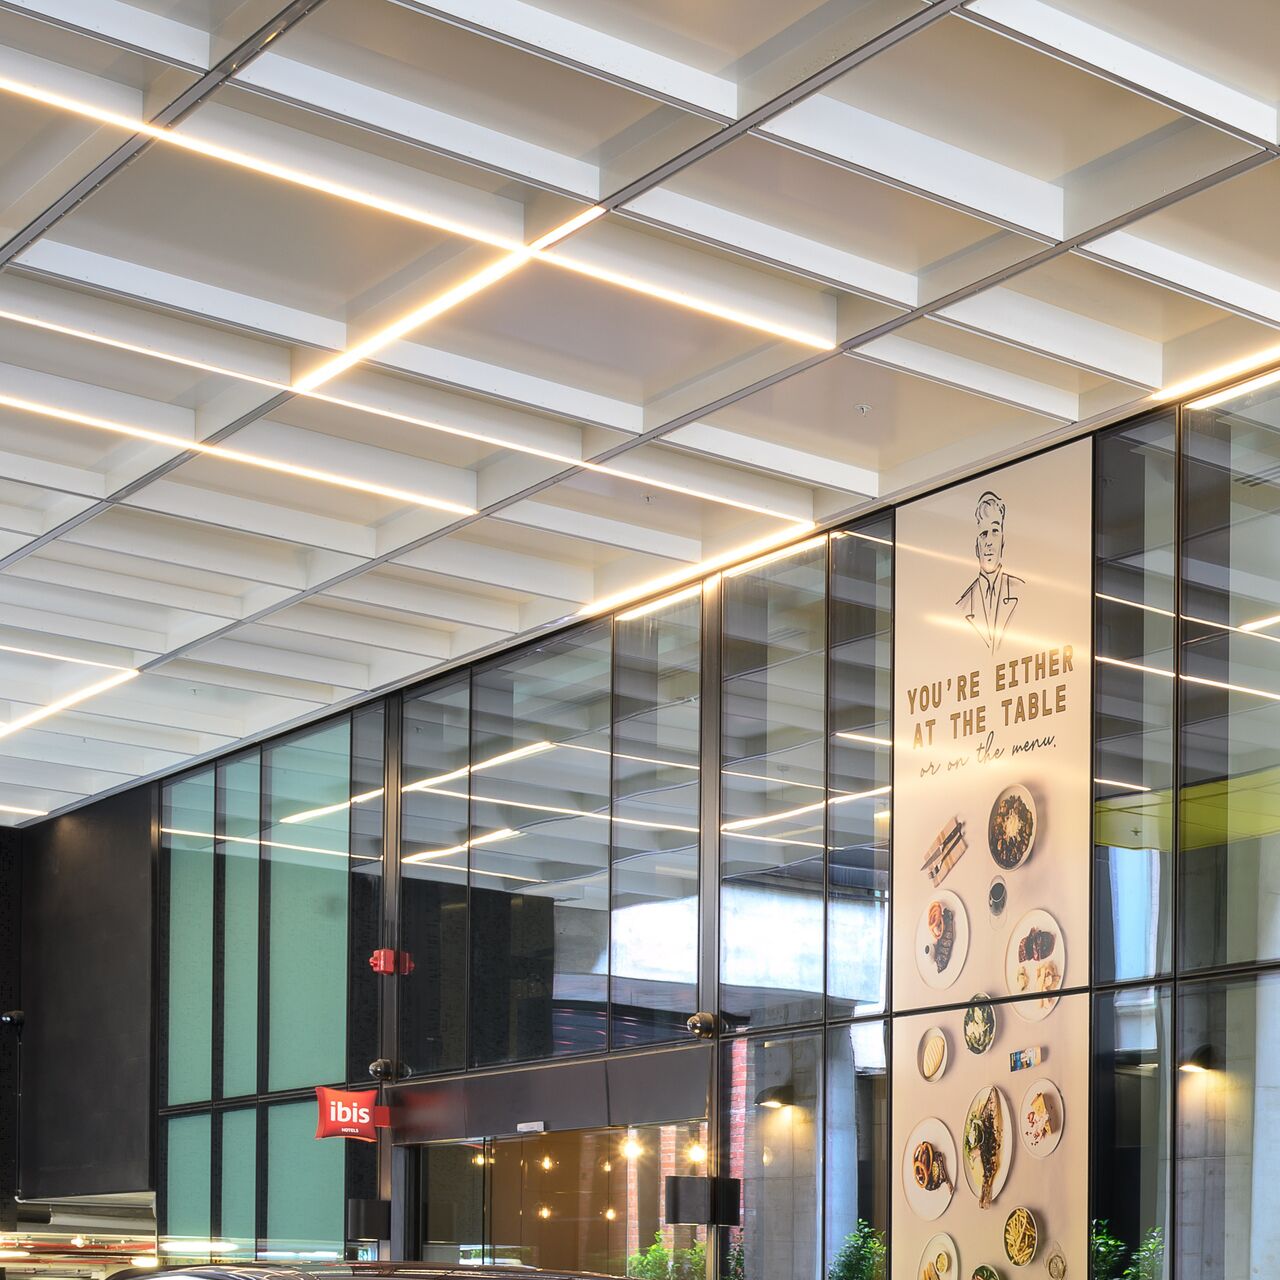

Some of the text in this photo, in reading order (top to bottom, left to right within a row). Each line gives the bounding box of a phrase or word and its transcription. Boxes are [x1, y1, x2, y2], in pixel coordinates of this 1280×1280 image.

[907, 645, 1075, 716] YOU'RE EITHER
[912, 685, 1067, 750] AT THE TABLE
[919, 761, 942, 778] or
[946, 755, 970, 772] on
[976, 731, 1005, 766] the
[330, 1101, 370, 1124] ibis
